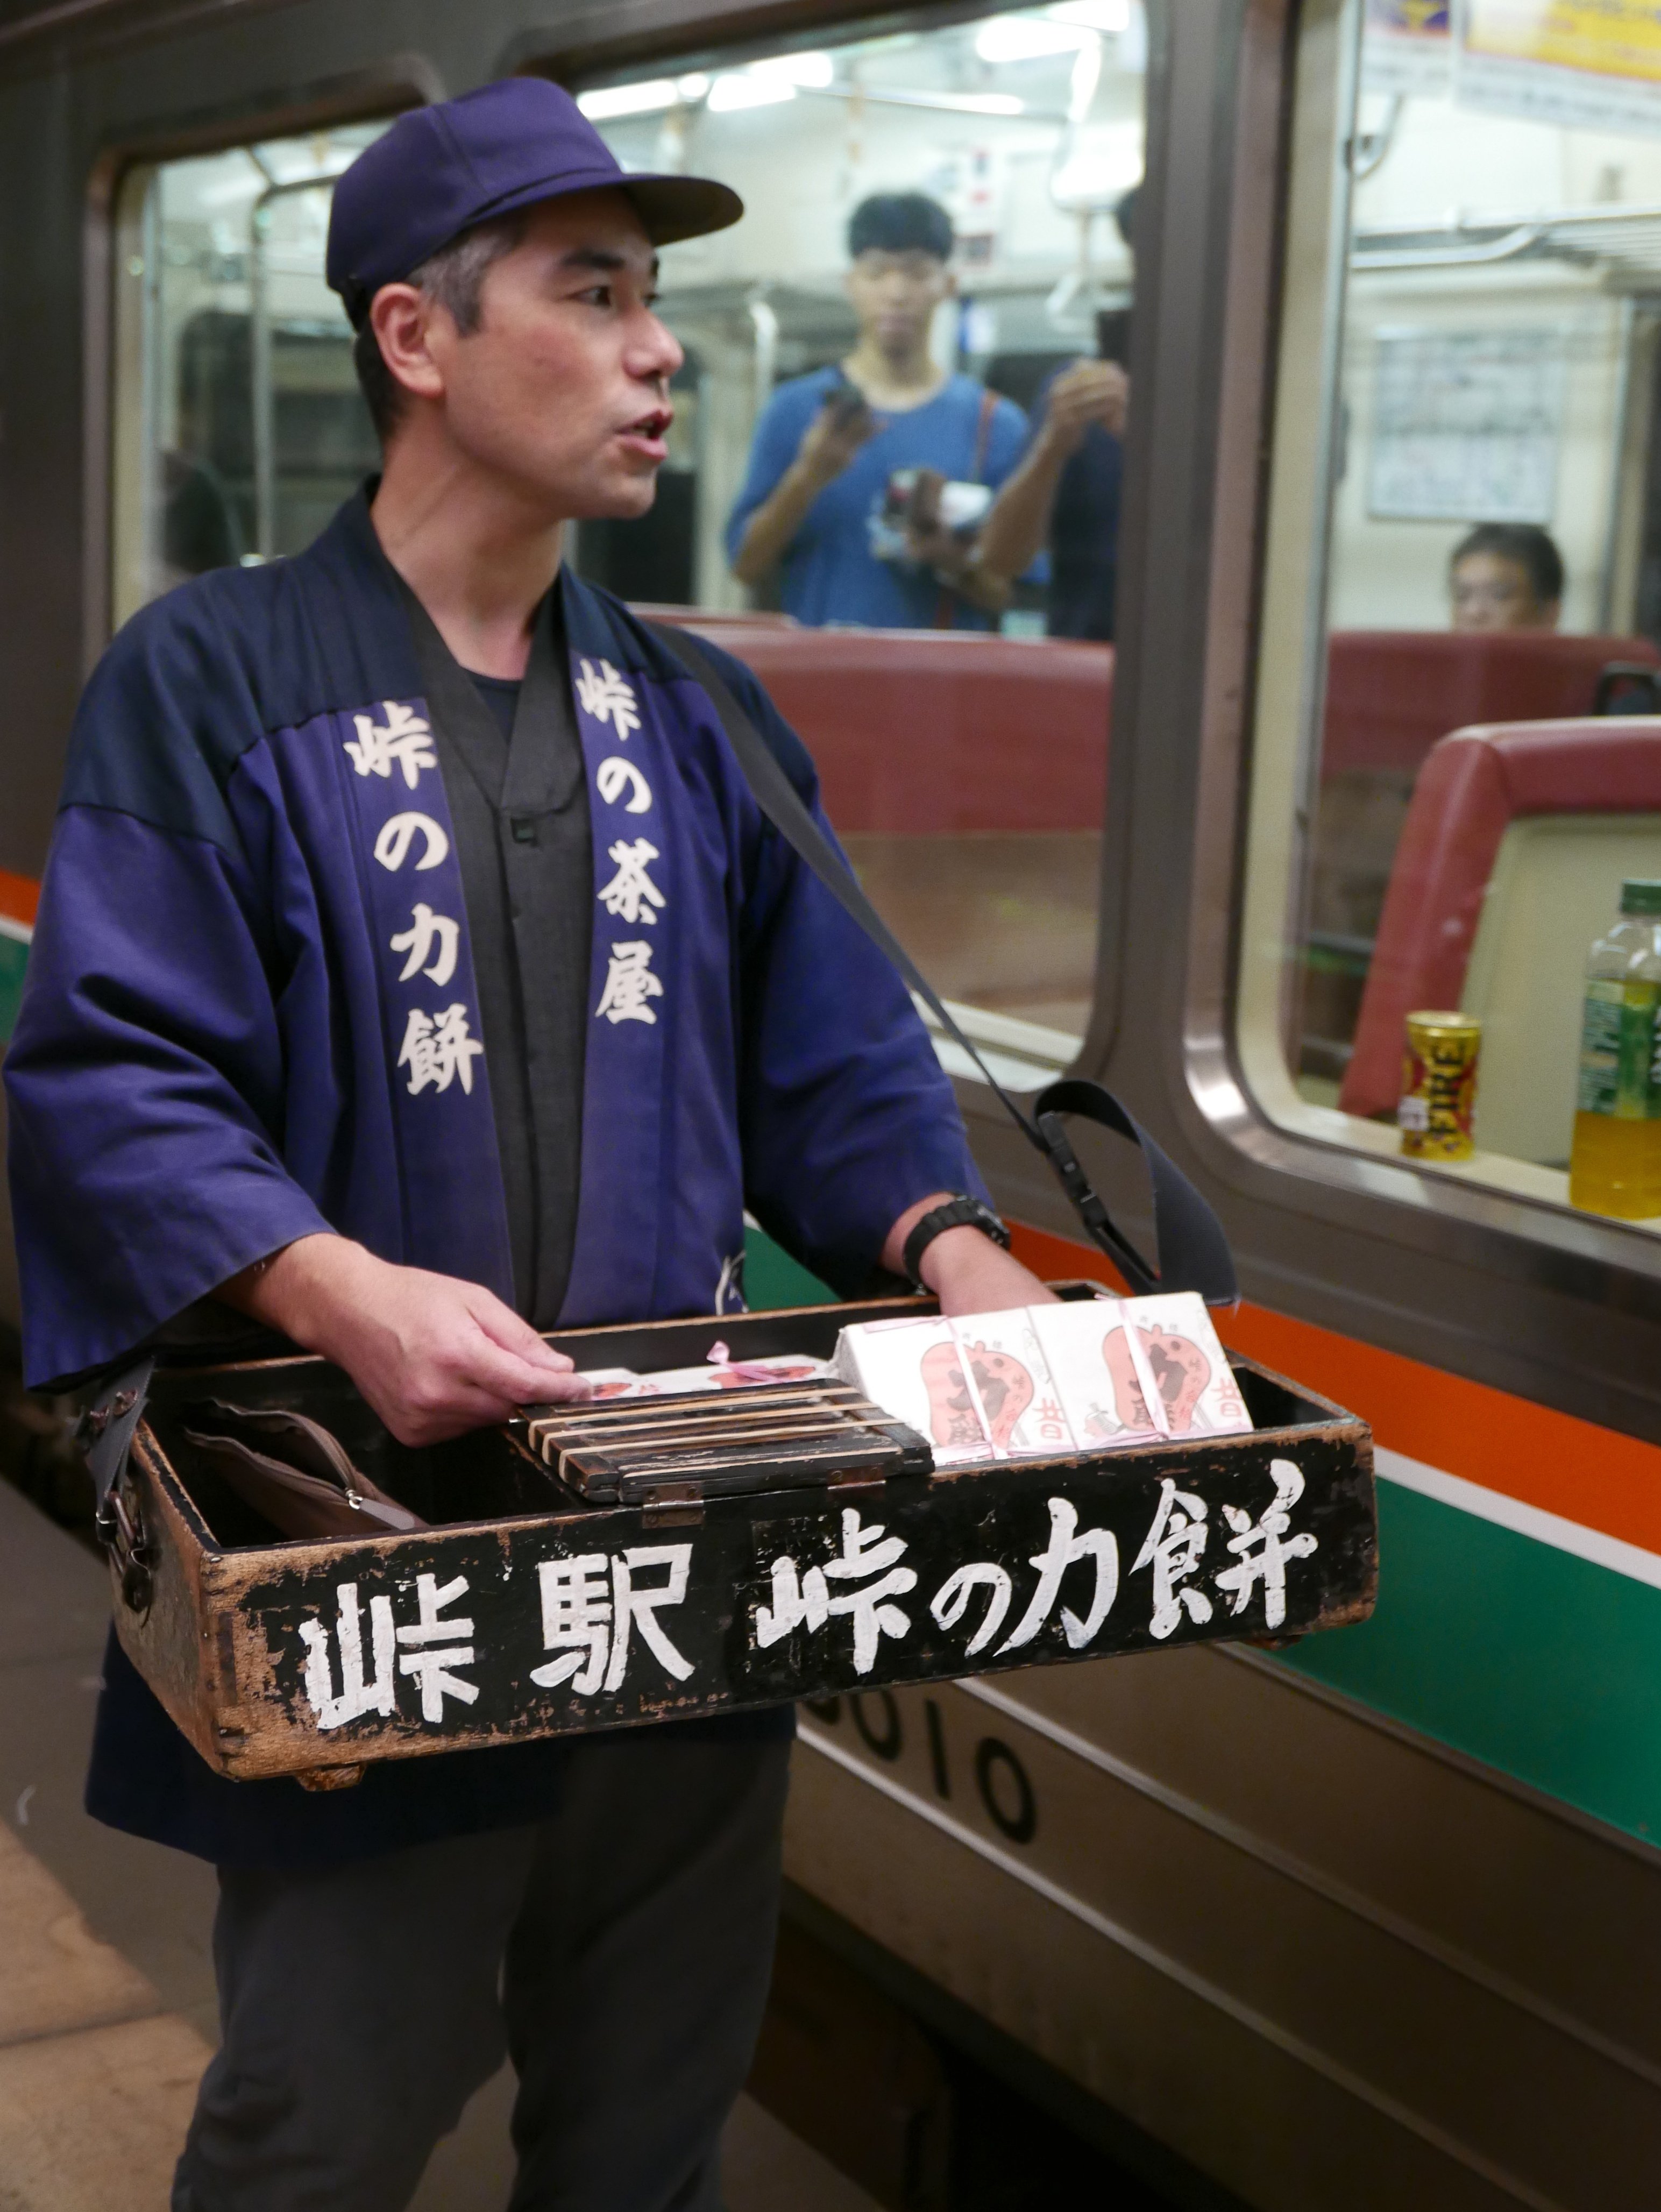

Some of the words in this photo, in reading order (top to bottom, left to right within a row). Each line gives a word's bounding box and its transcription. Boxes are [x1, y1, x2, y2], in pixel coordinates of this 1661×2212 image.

[343, 700, 485, 1096] 峠の力餅
[575, 657, 666, 1025] 峠の茶屋
[1426, 1043, 1465, 1134] FIRE
[803, 1688, 1037, 1845] 010
